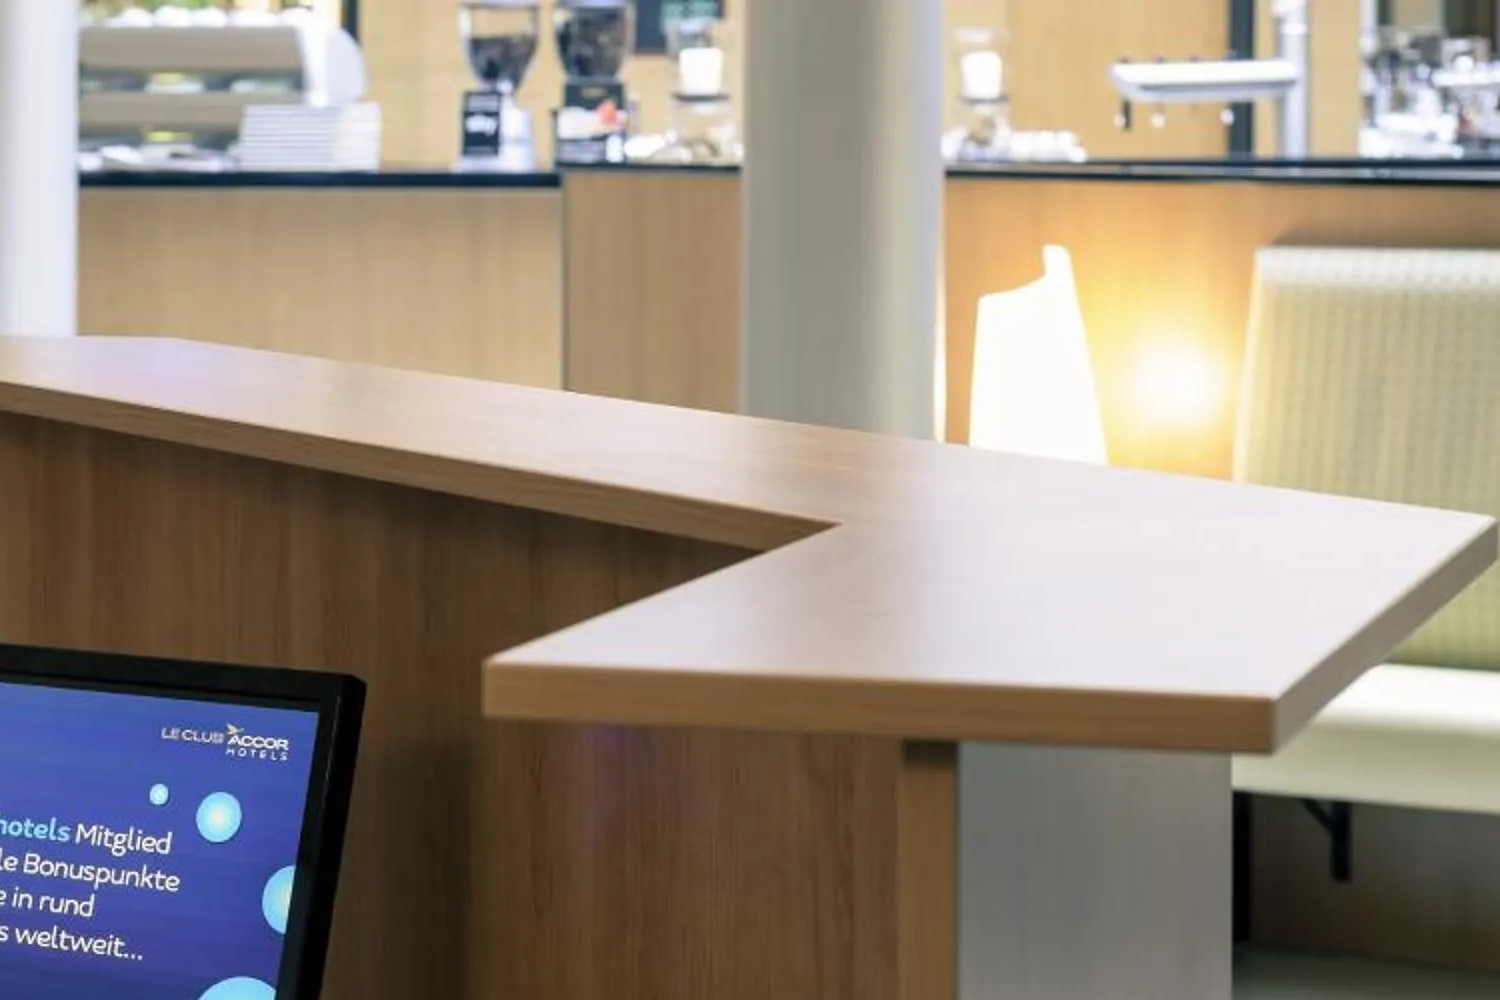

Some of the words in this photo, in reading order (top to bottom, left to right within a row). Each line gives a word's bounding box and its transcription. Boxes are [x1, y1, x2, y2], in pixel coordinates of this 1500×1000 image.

[160, 726, 180, 740] LE
[181, 728, 225, 745] CLUB
[227, 734, 289, 751] ACCOR
[225, 747, 289, 762] HOTELS
[75, 823, 173, 857] Mitglied
[23, 852, 180, 892] Bonuspunkte
[11, 886, 33, 910] in
[38, 893, 96, 918] rund
[15, 924, 144, 962] weltweit...
